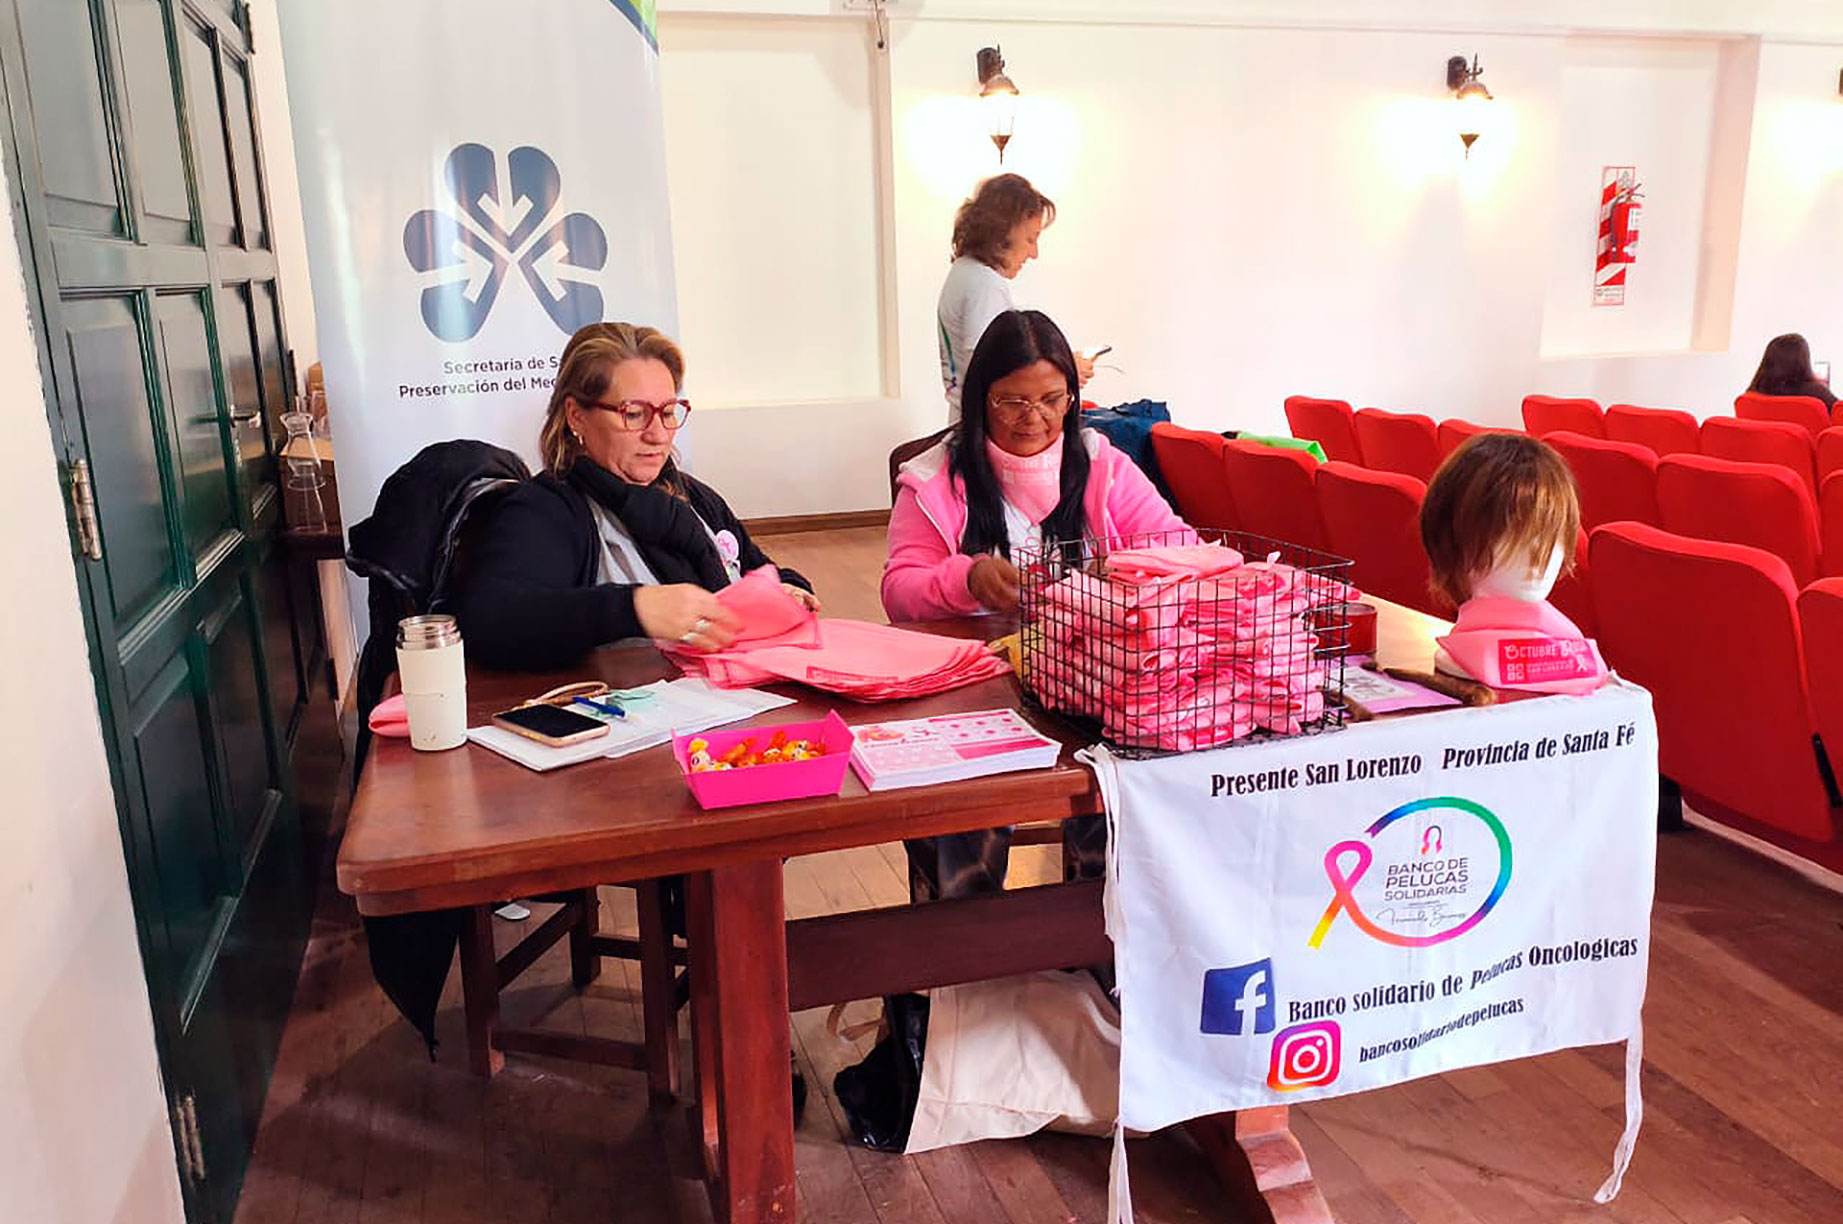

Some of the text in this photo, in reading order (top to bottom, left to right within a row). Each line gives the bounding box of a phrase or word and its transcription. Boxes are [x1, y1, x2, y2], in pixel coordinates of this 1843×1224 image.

[527, 356, 545, 369] de
[549, 355, 561, 368] S
[399, 379, 500, 398] Preservación
[503, 376, 527, 390] del
[1442, 721, 1636, 770] Provincia de Santa Fé
[1211, 754, 1423, 797] Presente San Lorenzo
[1387, 857, 1469, 876] BANCO DE
[1385, 869, 1469, 889] PELUCAS
[1383, 883, 1467, 901] SOLIDARIAS
[1288, 938, 1638, 1023] Banco solidario de Pelucas Oncologicas
[1359, 998, 1525, 1063] bancosolidariodepelucas
